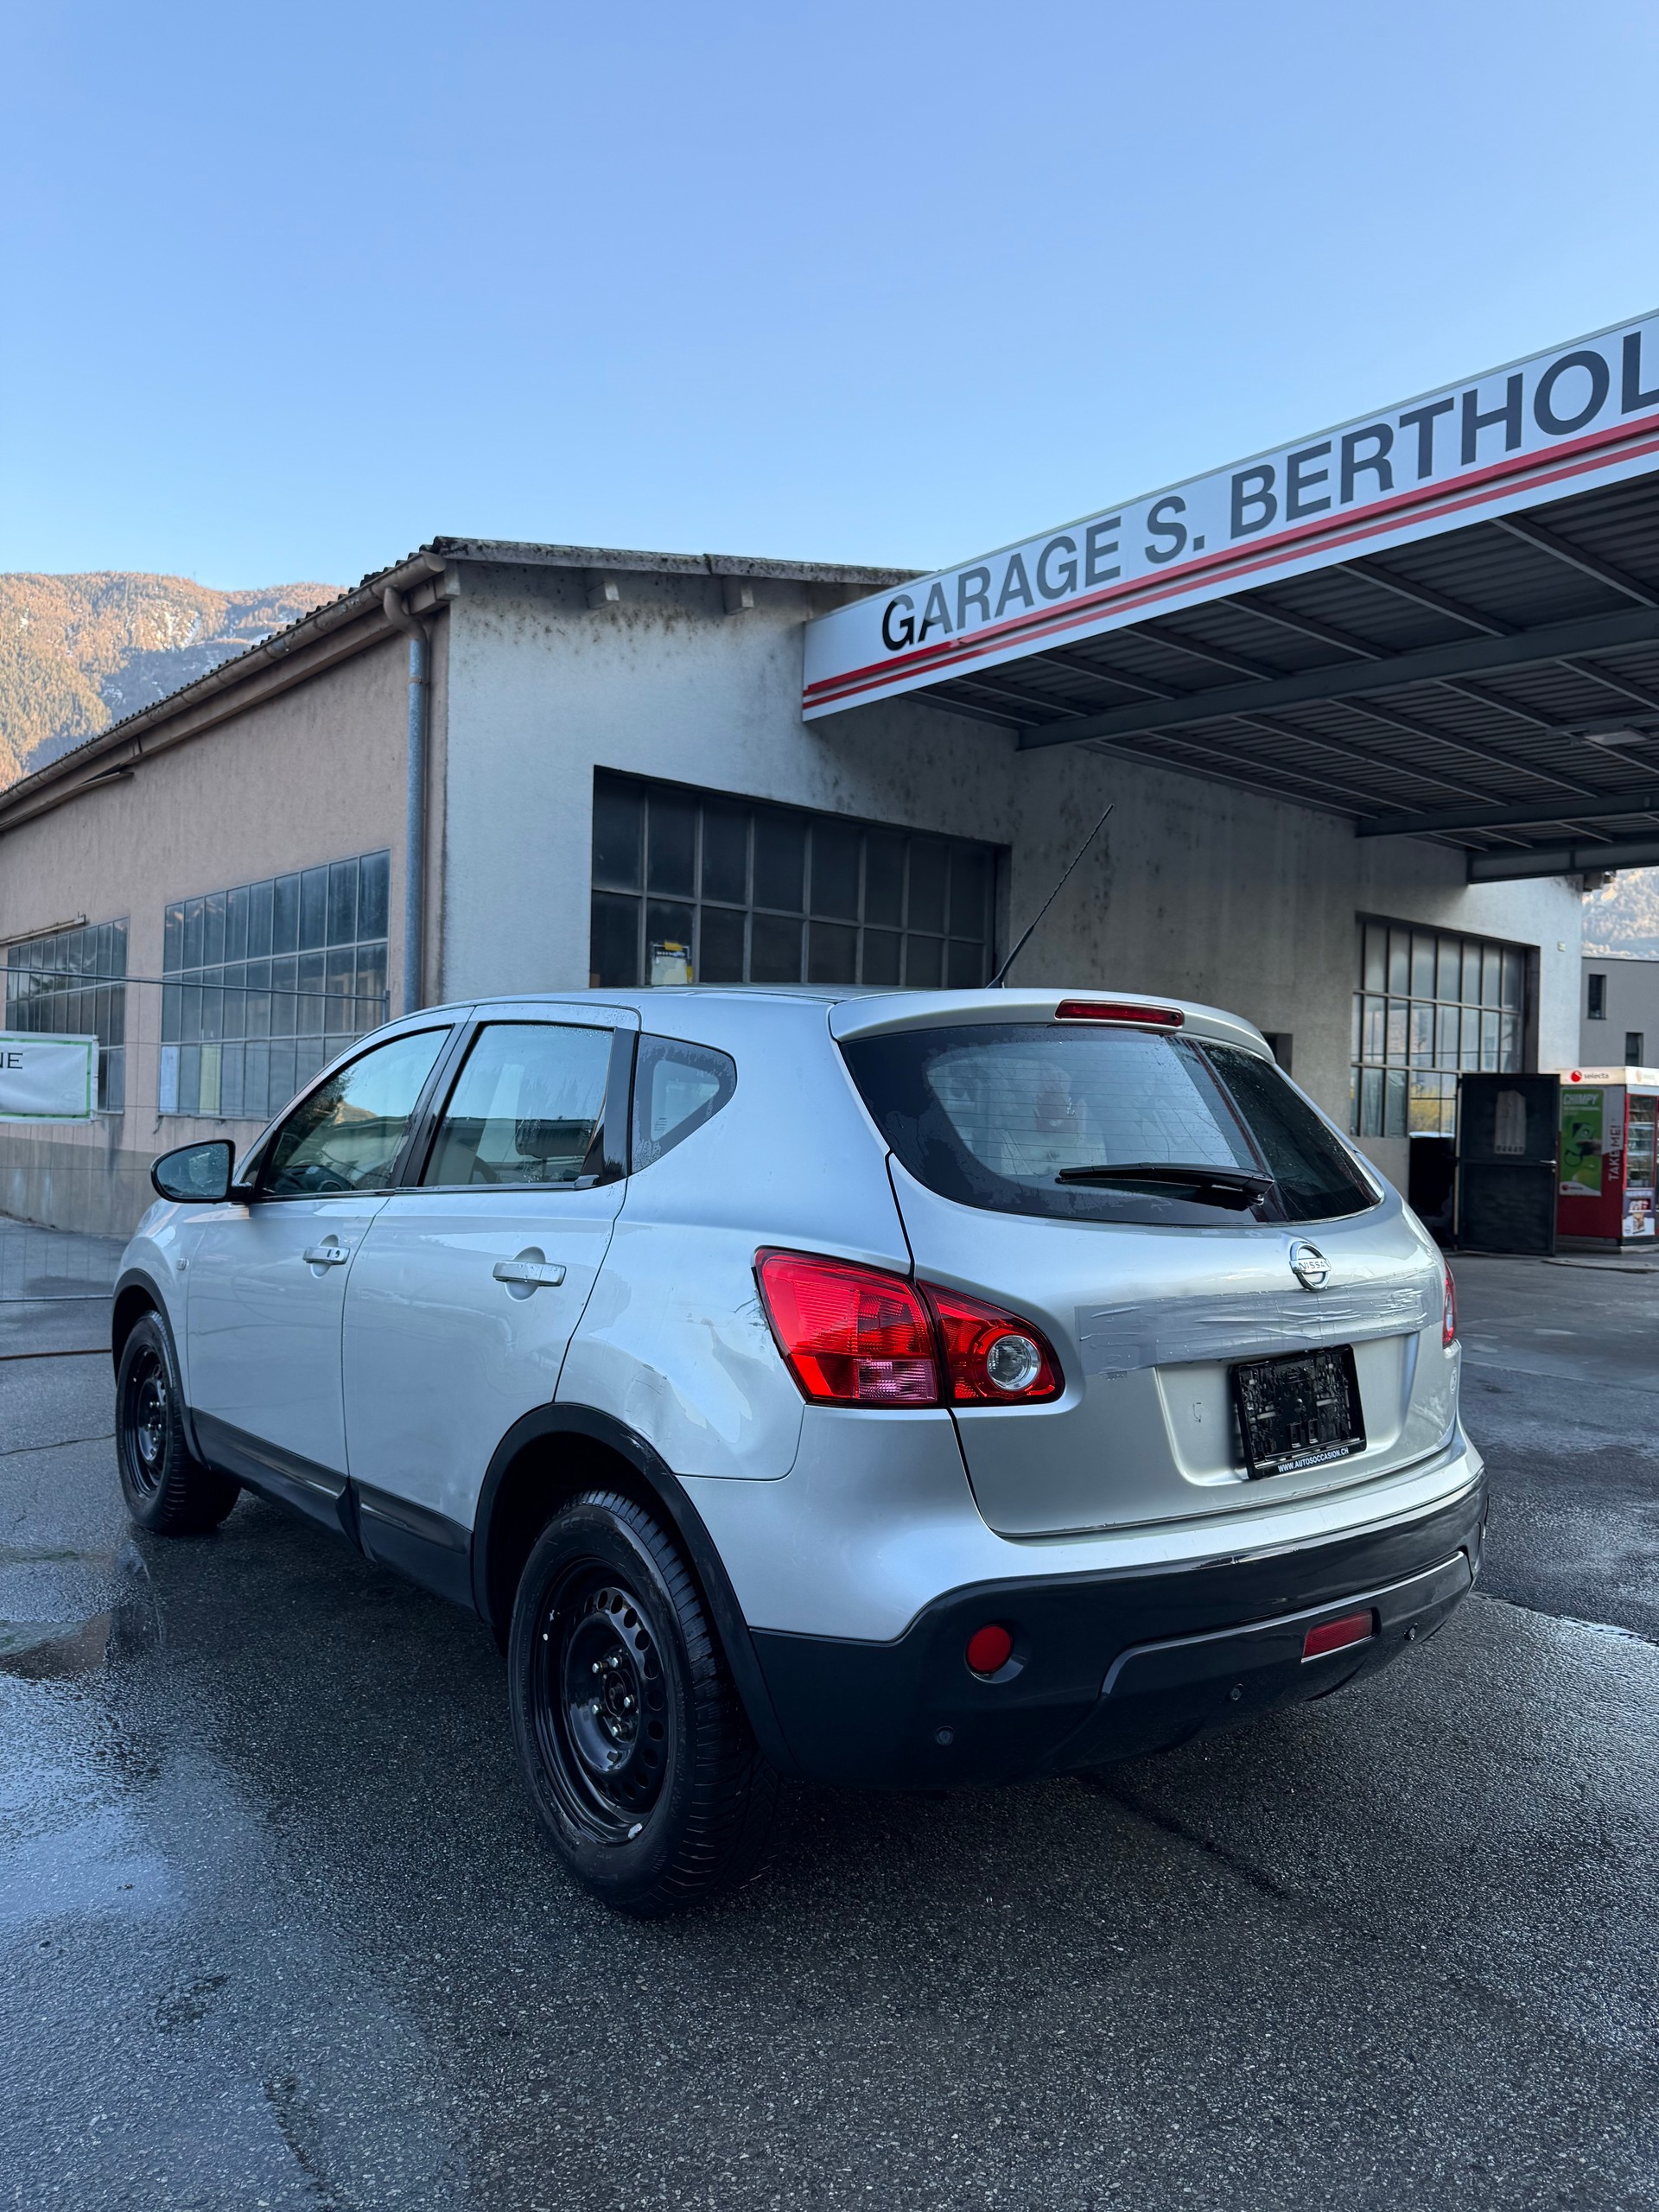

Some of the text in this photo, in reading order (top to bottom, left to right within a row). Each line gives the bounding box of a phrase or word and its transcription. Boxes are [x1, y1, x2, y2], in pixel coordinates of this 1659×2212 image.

[881, 331, 1659, 652] GARAGE S. BERTHOL
[1608, 1151, 1620, 1181] TAKE
[1278, 1446, 1350, 1473] WWW.AUTOSOCCASION.CH
